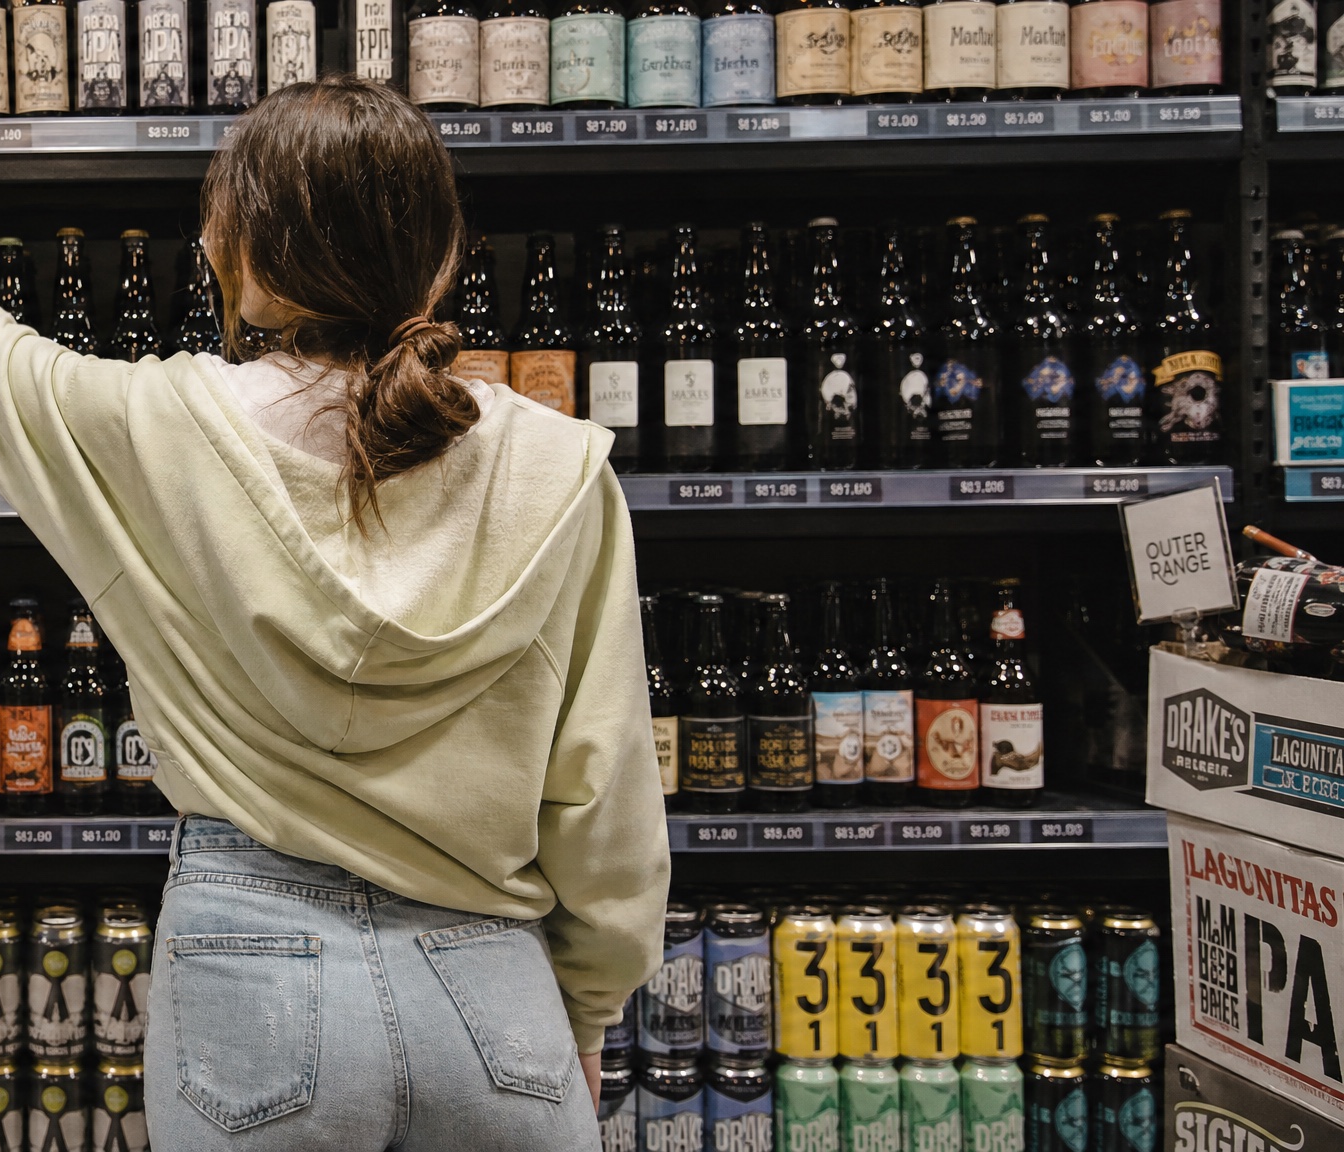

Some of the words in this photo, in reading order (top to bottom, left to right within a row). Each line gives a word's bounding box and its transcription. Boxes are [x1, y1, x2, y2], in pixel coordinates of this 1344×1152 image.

[1146, 532, 1208, 560] OUTER
[1150, 553, 1211, 586] RANGE
[1167, 696, 1245, 763] DRAKE'S
[1182, 840, 1338, 928] LAGUNITAS
[795, 941, 829, 1015] 3
[851, 941, 885, 1015] 3
[918, 943, 950, 1016] 3
[978, 941, 1012, 1015] 3
[809, 1020, 821, 1051] 1
[865, 1020, 878, 1052] 1
[931, 1022, 943, 1053] 1
[992, 1020, 1004, 1051] 1
